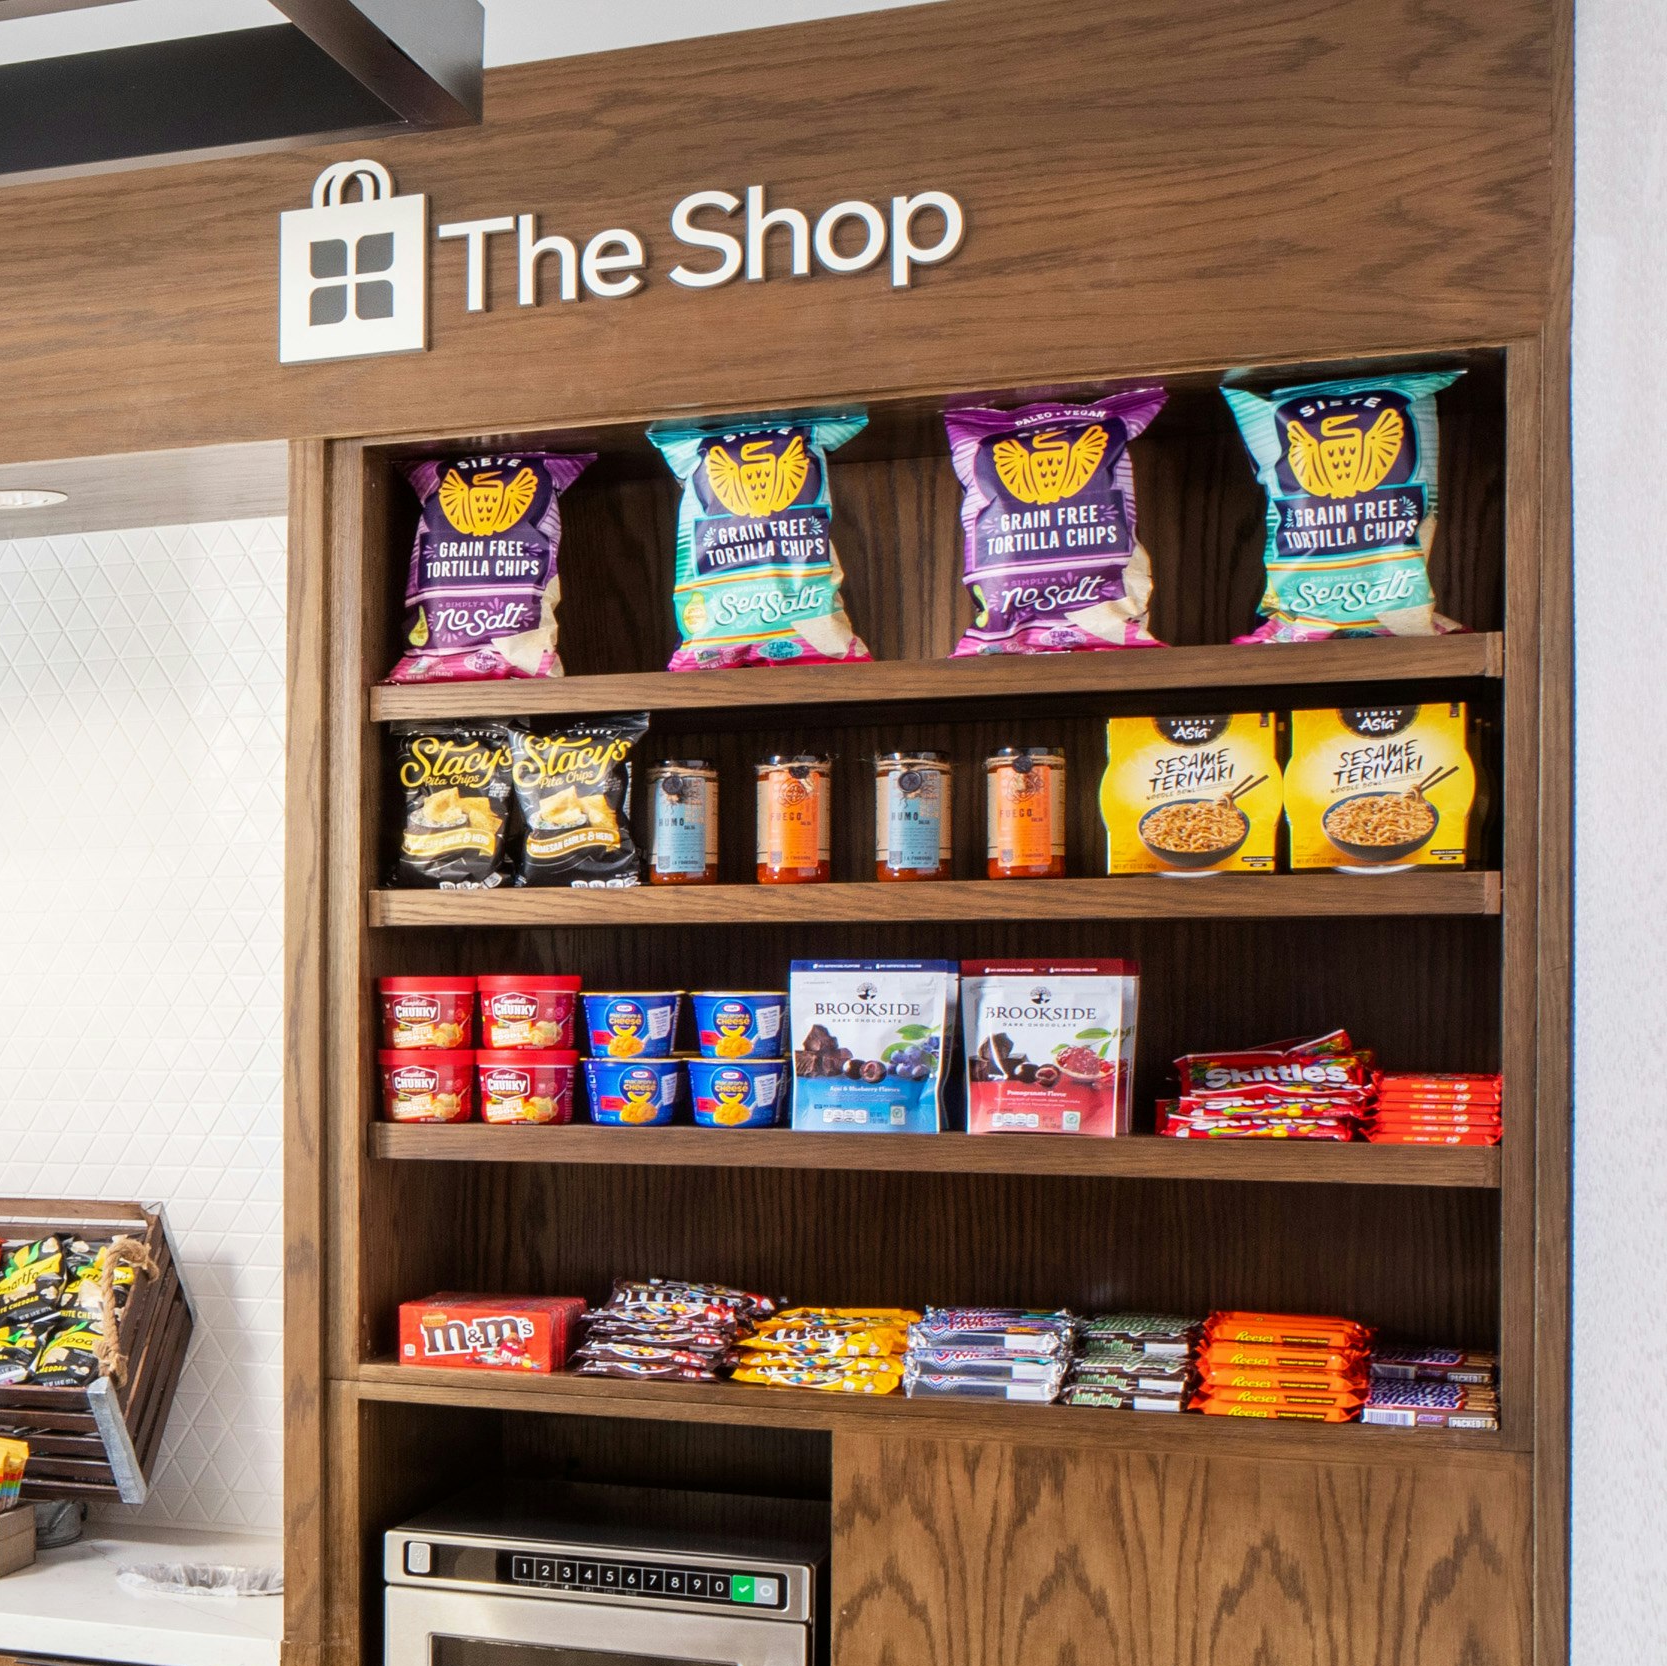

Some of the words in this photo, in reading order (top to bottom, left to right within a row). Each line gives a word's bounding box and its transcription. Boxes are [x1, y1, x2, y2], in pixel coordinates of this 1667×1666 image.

[438, 213, 647, 313] The
[669, 185, 966, 290] Shop
[1015, 412, 1052, 427] PALEO
[1063, 410, 1106, 418] VEGAN
[1001, 509, 1050, 532] GRAIN
[1058, 505, 1098, 526] FREE
[1295, 504, 1347, 528] GRAIN
[1355, 499, 1398, 521] FREE
[718, 523, 765, 545] GRAIN
[770, 518, 807, 538] FREE
[987, 530, 1059, 555] TORTILLA
[1066, 526, 1117, 547] CHIPS
[1284, 527, 1357, 549] TORTILLA
[1364, 520, 1418, 541] CHIPS
[439, 541, 484, 558] GRAIN
[489, 540, 524, 556] FREE
[706, 539, 775, 566] TORTILLA
[781, 538, 825, 557] CHIPS
[427, 561, 489, 578] TORTILLA
[495, 560, 540, 576] CHIPS
[1173, 727, 1211, 739] Asia
[1359, 718, 1398, 731] Asia
[400, 737, 513, 788] Stacy's
[512, 736, 632, 788] Stacy's
[1155, 748, 1229, 776] SESAME
[1339, 739, 1418, 768] SESAME
[1148, 764, 1234, 793] TERIYAKI
[1333, 755, 1423, 786] TERIYAKI
[450, 774, 480, 786] Chips
[540, 778, 564, 789] Pita
[566, 771, 594, 783] Chips
[658, 817, 685, 827] HUMO
[891, 812, 918, 821] HUMO
[395, 1006, 437, 1019] CHUNKY
[494, 1004, 536, 1017] CHUNKY
[815, 1003, 920, 1016] BROOKSIDE
[986, 1006, 1097, 1021] BROOKSIDE
[394, 1077, 436, 1090] CHUNKY
[488, 1078, 526, 1092] CHUNKY
[1205, 1064, 1349, 1089] Skittles
[9, 1296, 39, 1310] CHEDDAR
[522, 1563, 527, 1574] 1
[542, 1565, 550, 1577] 2
[563, 1567, 571, 1579] 3
[584, 1569, 593, 1580] 4
[605, 1570, 614, 1582] 5
[627, 1572, 636, 1584] 6
[649, 1574, 657, 1586] 7
[671, 1577, 679, 1588] 8
[693, 1578, 701, 1590] 9
[715, 1581, 724, 1593] 0
